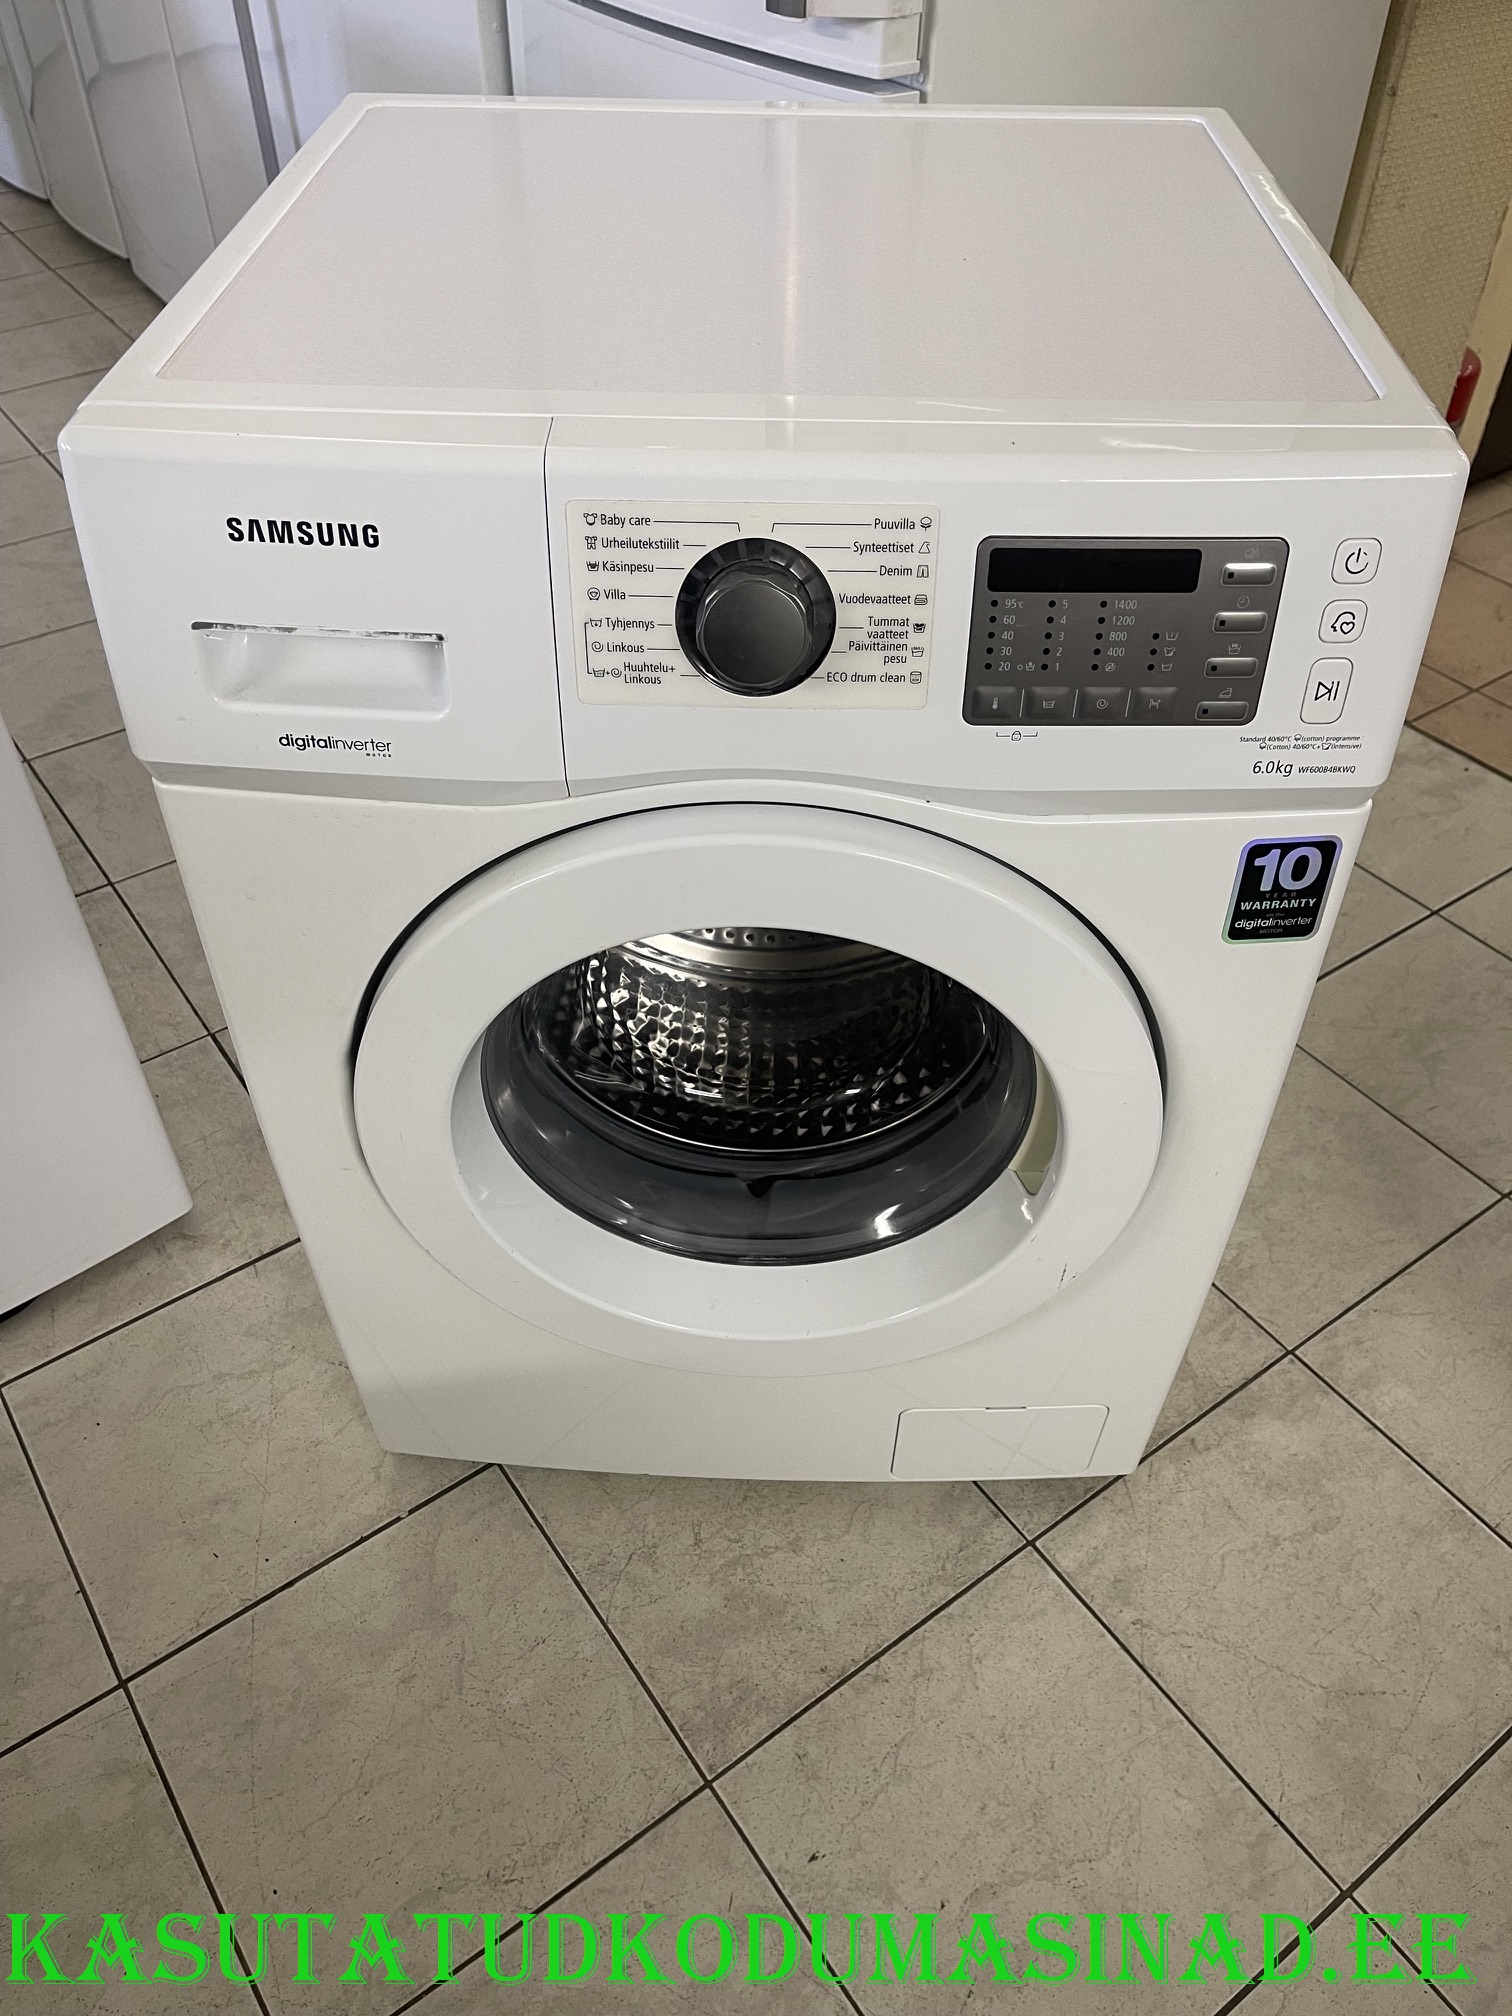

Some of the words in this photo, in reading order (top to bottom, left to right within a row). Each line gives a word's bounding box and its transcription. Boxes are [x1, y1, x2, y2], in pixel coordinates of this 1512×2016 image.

[600, 514, 626, 528] Baby
[629, 516, 651, 526] care
[874, 518, 916, 530] Puuvilla
[226, 517, 380, 548] SAMSUNG
[601, 538, 680, 550] Urheilutekstiilit
[853, 541, 915, 555] Synteettiset
[602, 561, 654, 574] Käsinpesu
[879, 565, 913, 577] Denim
[603, 588, 626, 600] Villa
[839, 593, 911, 605] Vuodevaatteet
[1062, 599, 1068, 609] 5
[1114, 600, 1138, 610] 1400
[605, 617, 655, 631] Tyhjennys
[868, 616, 910, 628] Tummat
[1003, 615, 1016, 625] 60
[1060, 615, 1067, 625] 4
[1112, 616, 1136, 626] 1200
[867, 628, 909, 640] vaatteet
[1001, 630, 1014, 640] 40
[1058, 631, 1065, 641] 3
[1109, 632, 1128, 641] 800
[606, 641, 645, 653] Linkous
[848, 640, 908, 652] Päivittäinen
[1000, 646, 1012, 656] 30
[1056, 647, 1063, 657] 2
[1107, 647, 1125, 657] 400
[883, 655, 907, 666] pesu
[998, 661, 1011, 671] 20
[1056, 662, 1060, 671] 1
[623, 661, 676, 675] Huuhtelu+
[624, 673, 662, 685] Linkous
[826, 671, 847, 683] ECO
[850, 671, 875, 683] drum
[879, 671, 906, 683] clean
[278, 733, 392, 751] digitalinverter
[1252, 760, 1294, 777] 6.0kg
[1298, 765, 1356, 774] WF600B4BKWQ
[1254, 846, 1323, 892] 10
[1240, 898, 1317, 911] WARRANTY
